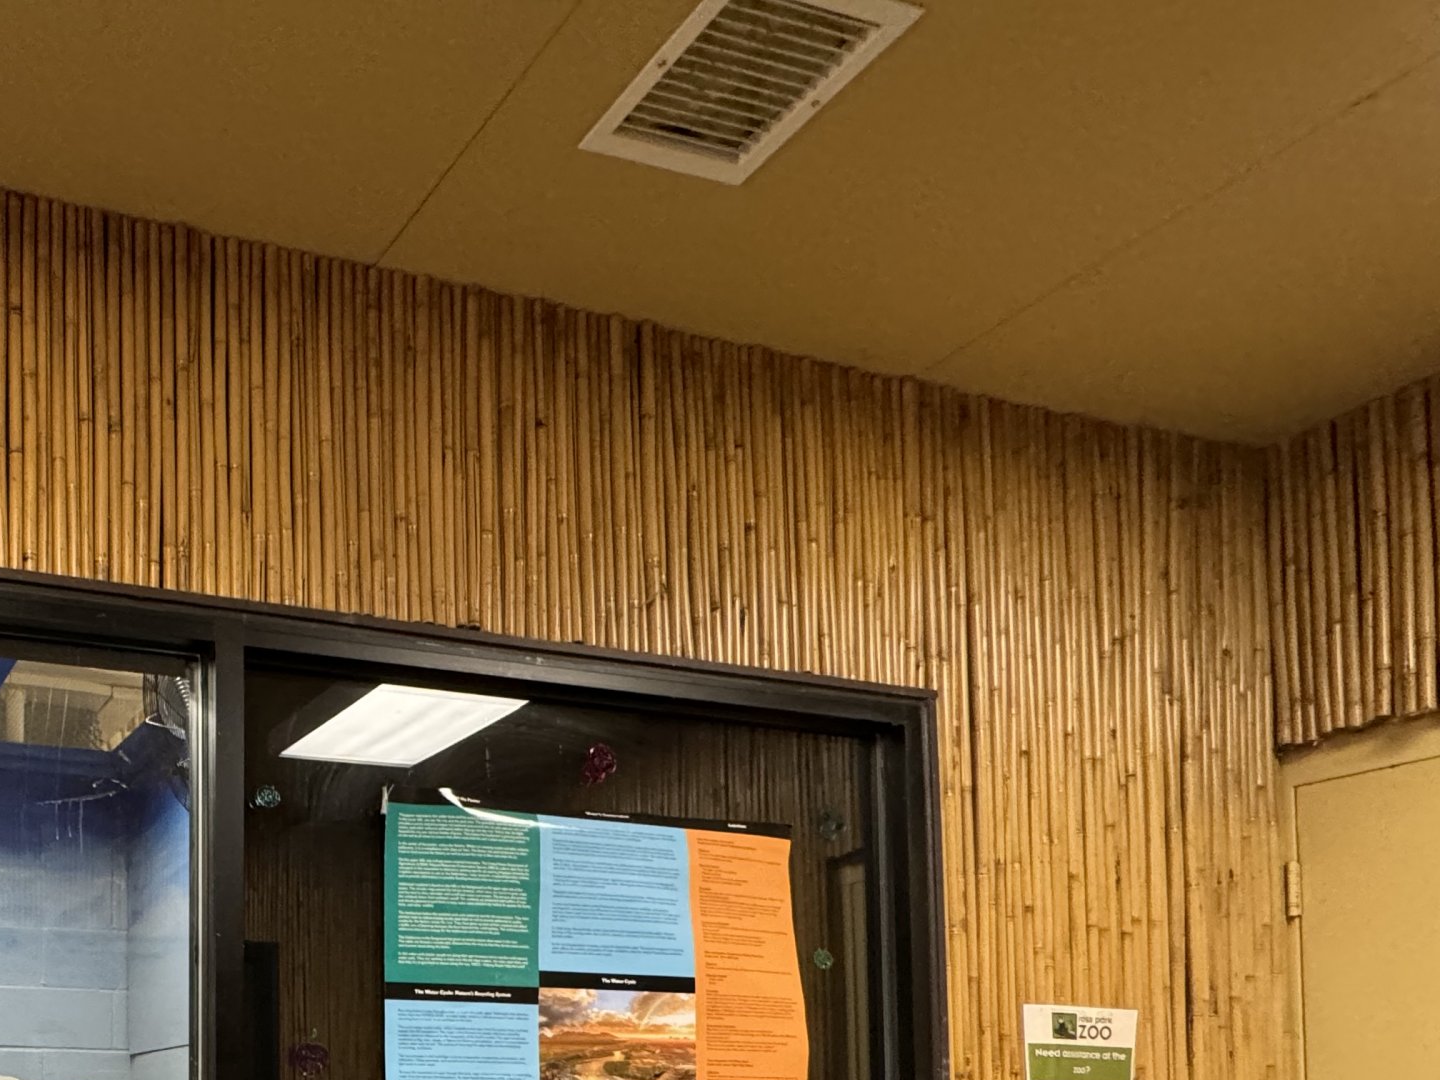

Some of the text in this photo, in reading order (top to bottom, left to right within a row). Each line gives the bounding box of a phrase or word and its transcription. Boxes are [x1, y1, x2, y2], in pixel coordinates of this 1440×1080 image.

[1095, 1016, 1113, 1024] park
[1078, 1025, 1112, 1040] ZOO
[1035, 1048, 1061, 1057] Need
[1102, 1052, 1111, 1060] at
[1112, 1052, 1126, 1060] the
[1072, 1066, 1091, 1074] zoo?
